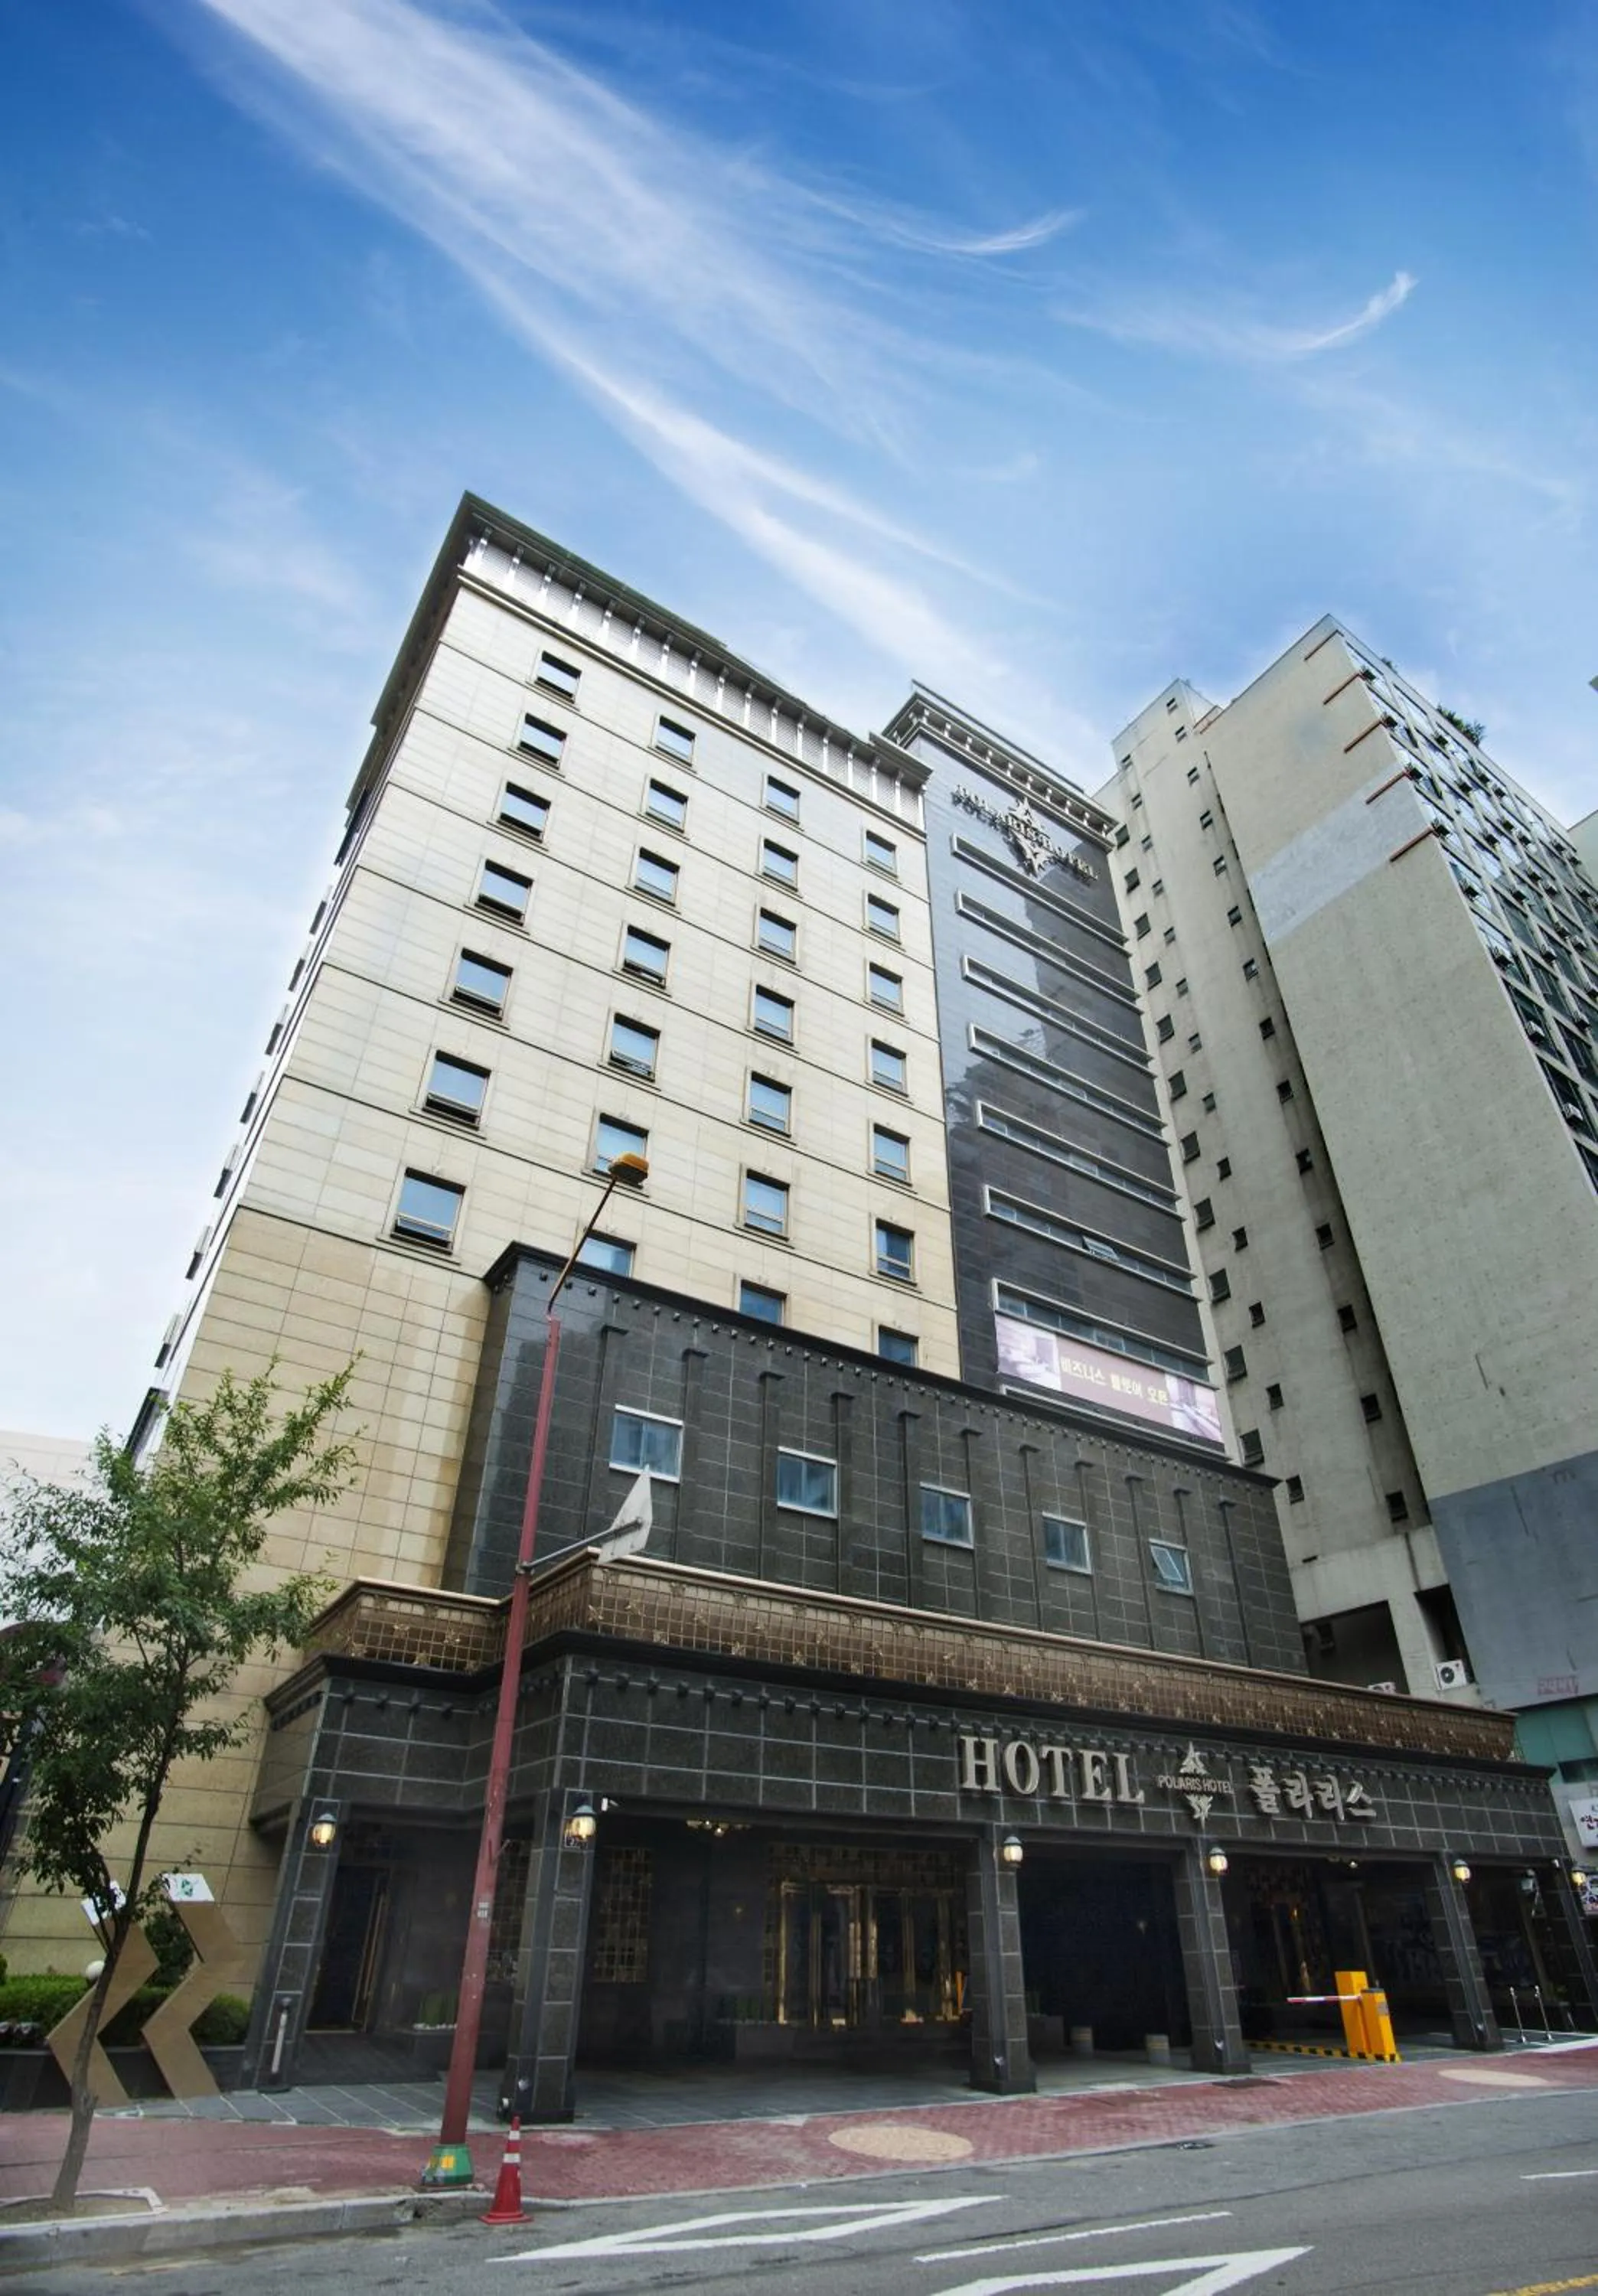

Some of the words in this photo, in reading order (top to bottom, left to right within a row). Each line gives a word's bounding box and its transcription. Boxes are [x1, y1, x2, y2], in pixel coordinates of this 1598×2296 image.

[1060, 1358, 1107, 1385] 비즈니스
[960, 1736, 1144, 1803] HOTEL
[1157, 1775, 1202, 1791] POLARIS
[1202, 1777, 1234, 1795] HOTEL
[1248, 1766, 1377, 1821] 폴라리스
